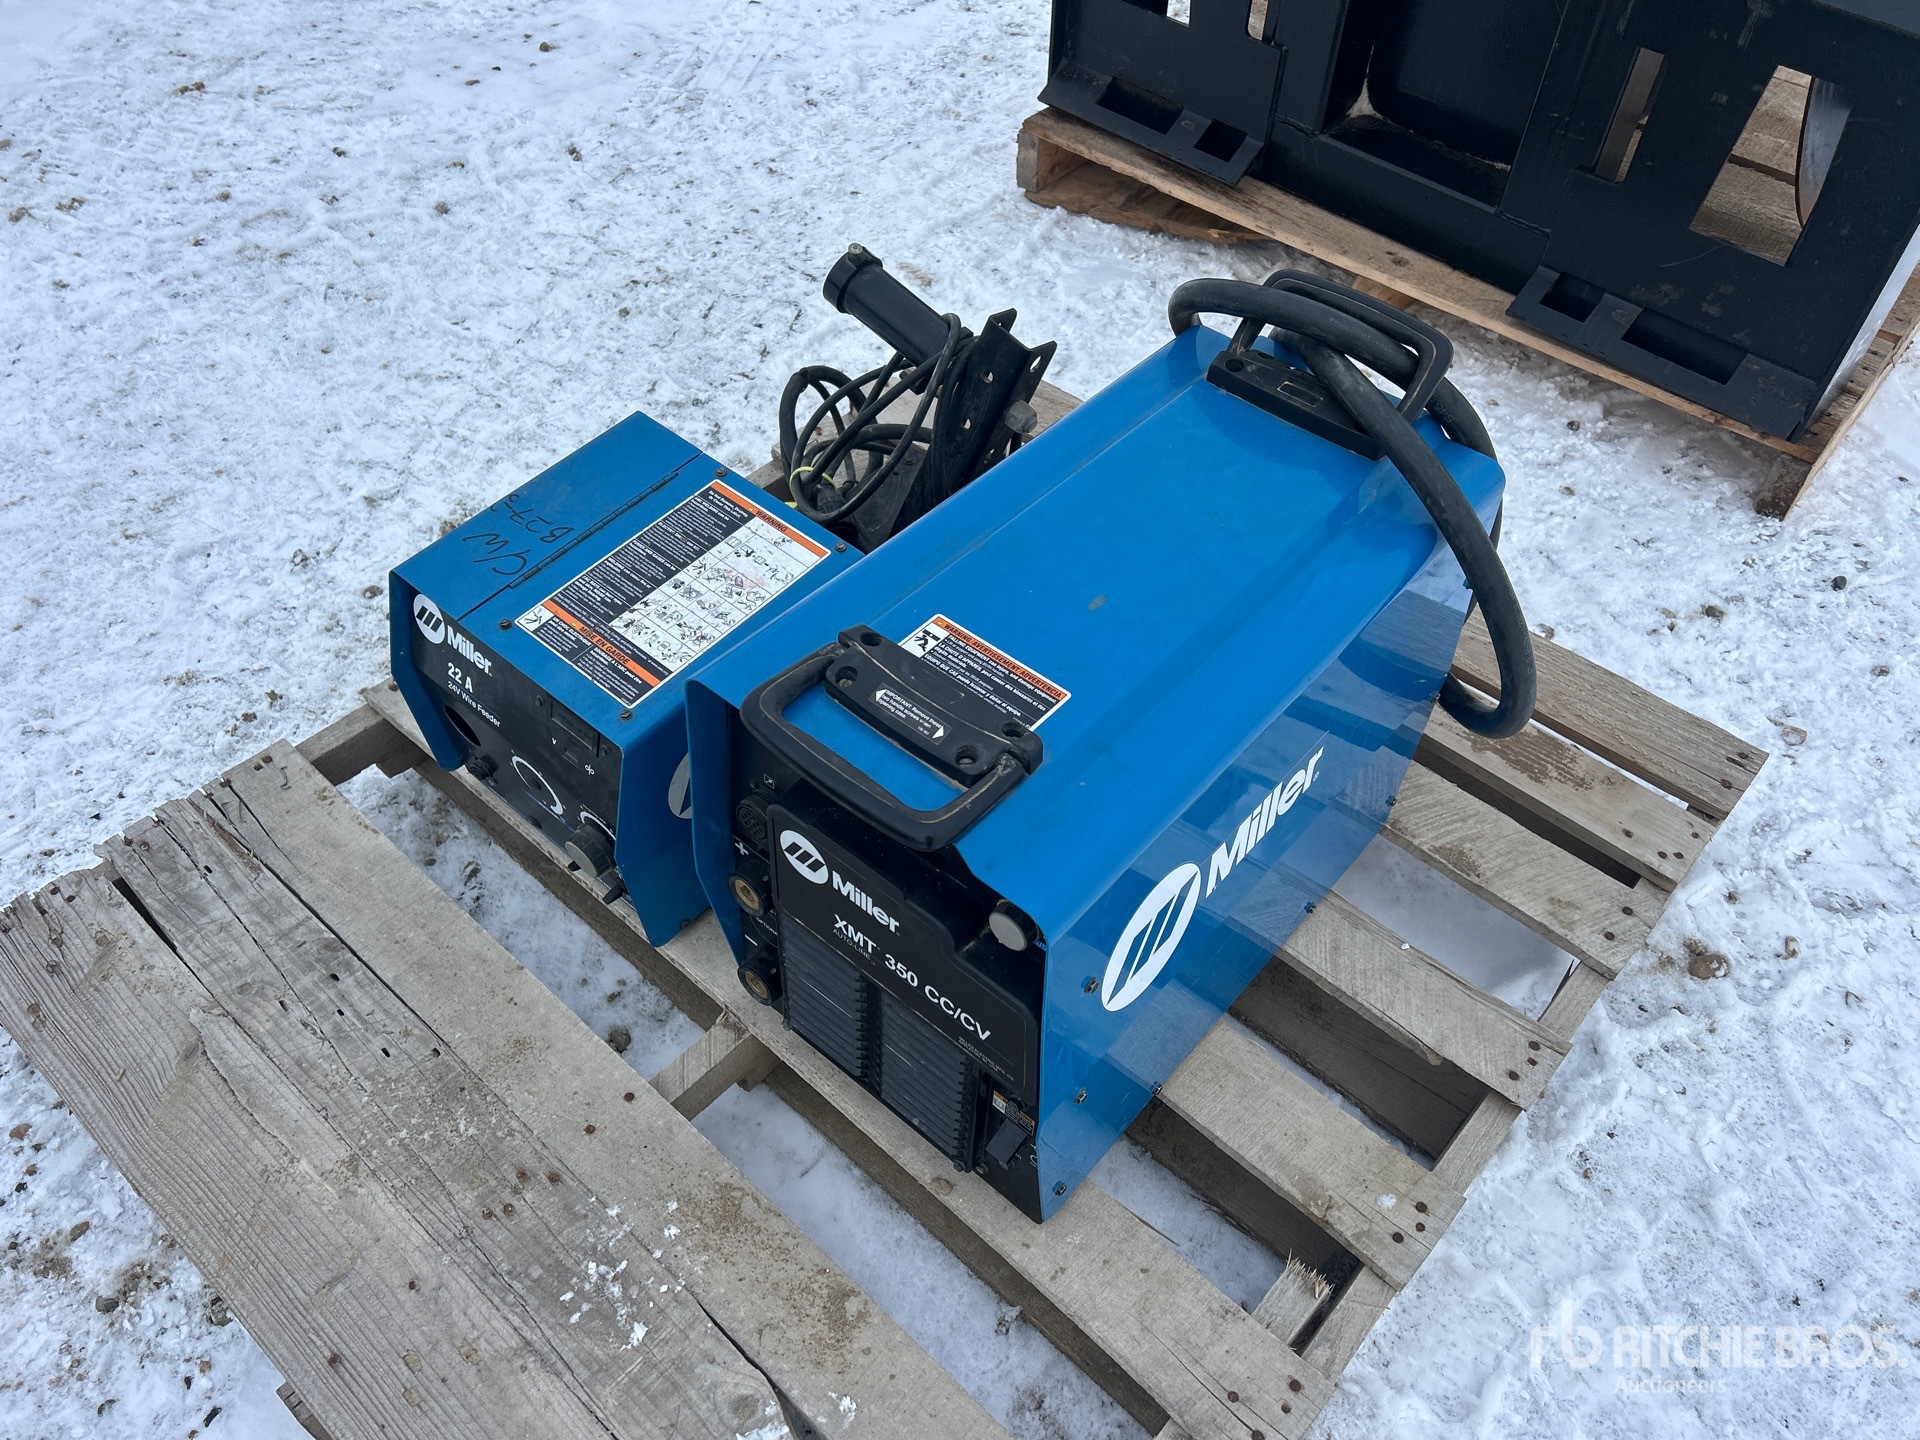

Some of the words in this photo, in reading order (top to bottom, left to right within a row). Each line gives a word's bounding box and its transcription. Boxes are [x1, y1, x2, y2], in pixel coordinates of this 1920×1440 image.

[754, 510, 788, 532] WARNING
[447, 625, 492, 674] Miller
[577, 626, 595, 639] MISE
[594, 638, 607, 647] EN
[604, 645, 630, 664] GARDE
[448, 662, 462, 684] 22
[465, 676, 474, 693] A
[448, 681, 461, 695] 24V
[461, 690, 477, 708] Wire
[477, 704, 501, 727] Feeder
[888, 698, 905, 711] handle
[911, 706, 930, 720] Remove
[1206, 746, 1324, 898] Miller
[832, 870, 900, 933] Miller
[832, 928, 871, 960] AUTO-LINE
[834, 913, 877, 953] XMT
[884, 953, 918, 987] 350
[924, 985, 991, 1040] CC/CV
